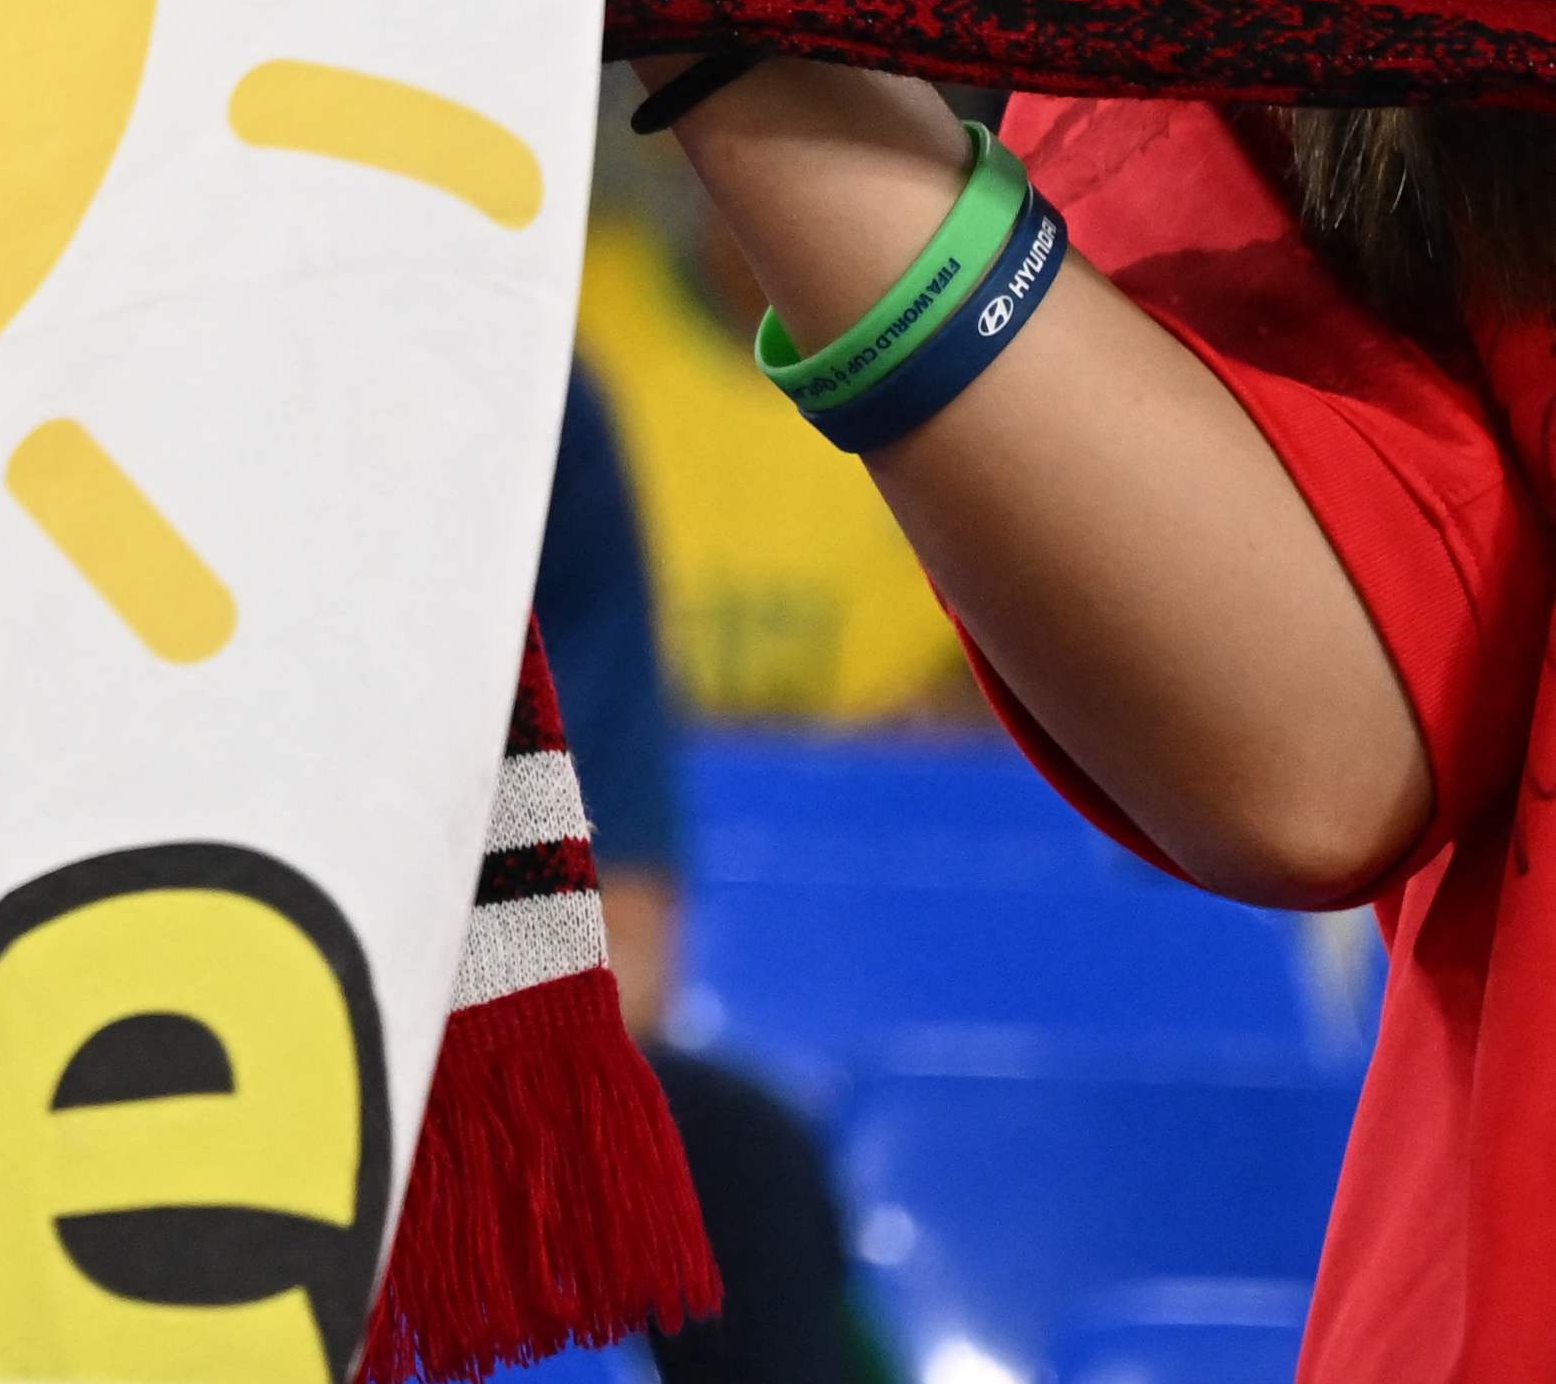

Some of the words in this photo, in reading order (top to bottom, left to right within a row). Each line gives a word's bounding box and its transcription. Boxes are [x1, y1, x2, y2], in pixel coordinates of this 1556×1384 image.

[926, 256, 962, 295] FIFA
[1008, 215, 1058, 300] HYUNDAI
[875, 292, 934, 350] WORLD
[848, 347, 878, 374] CUP
